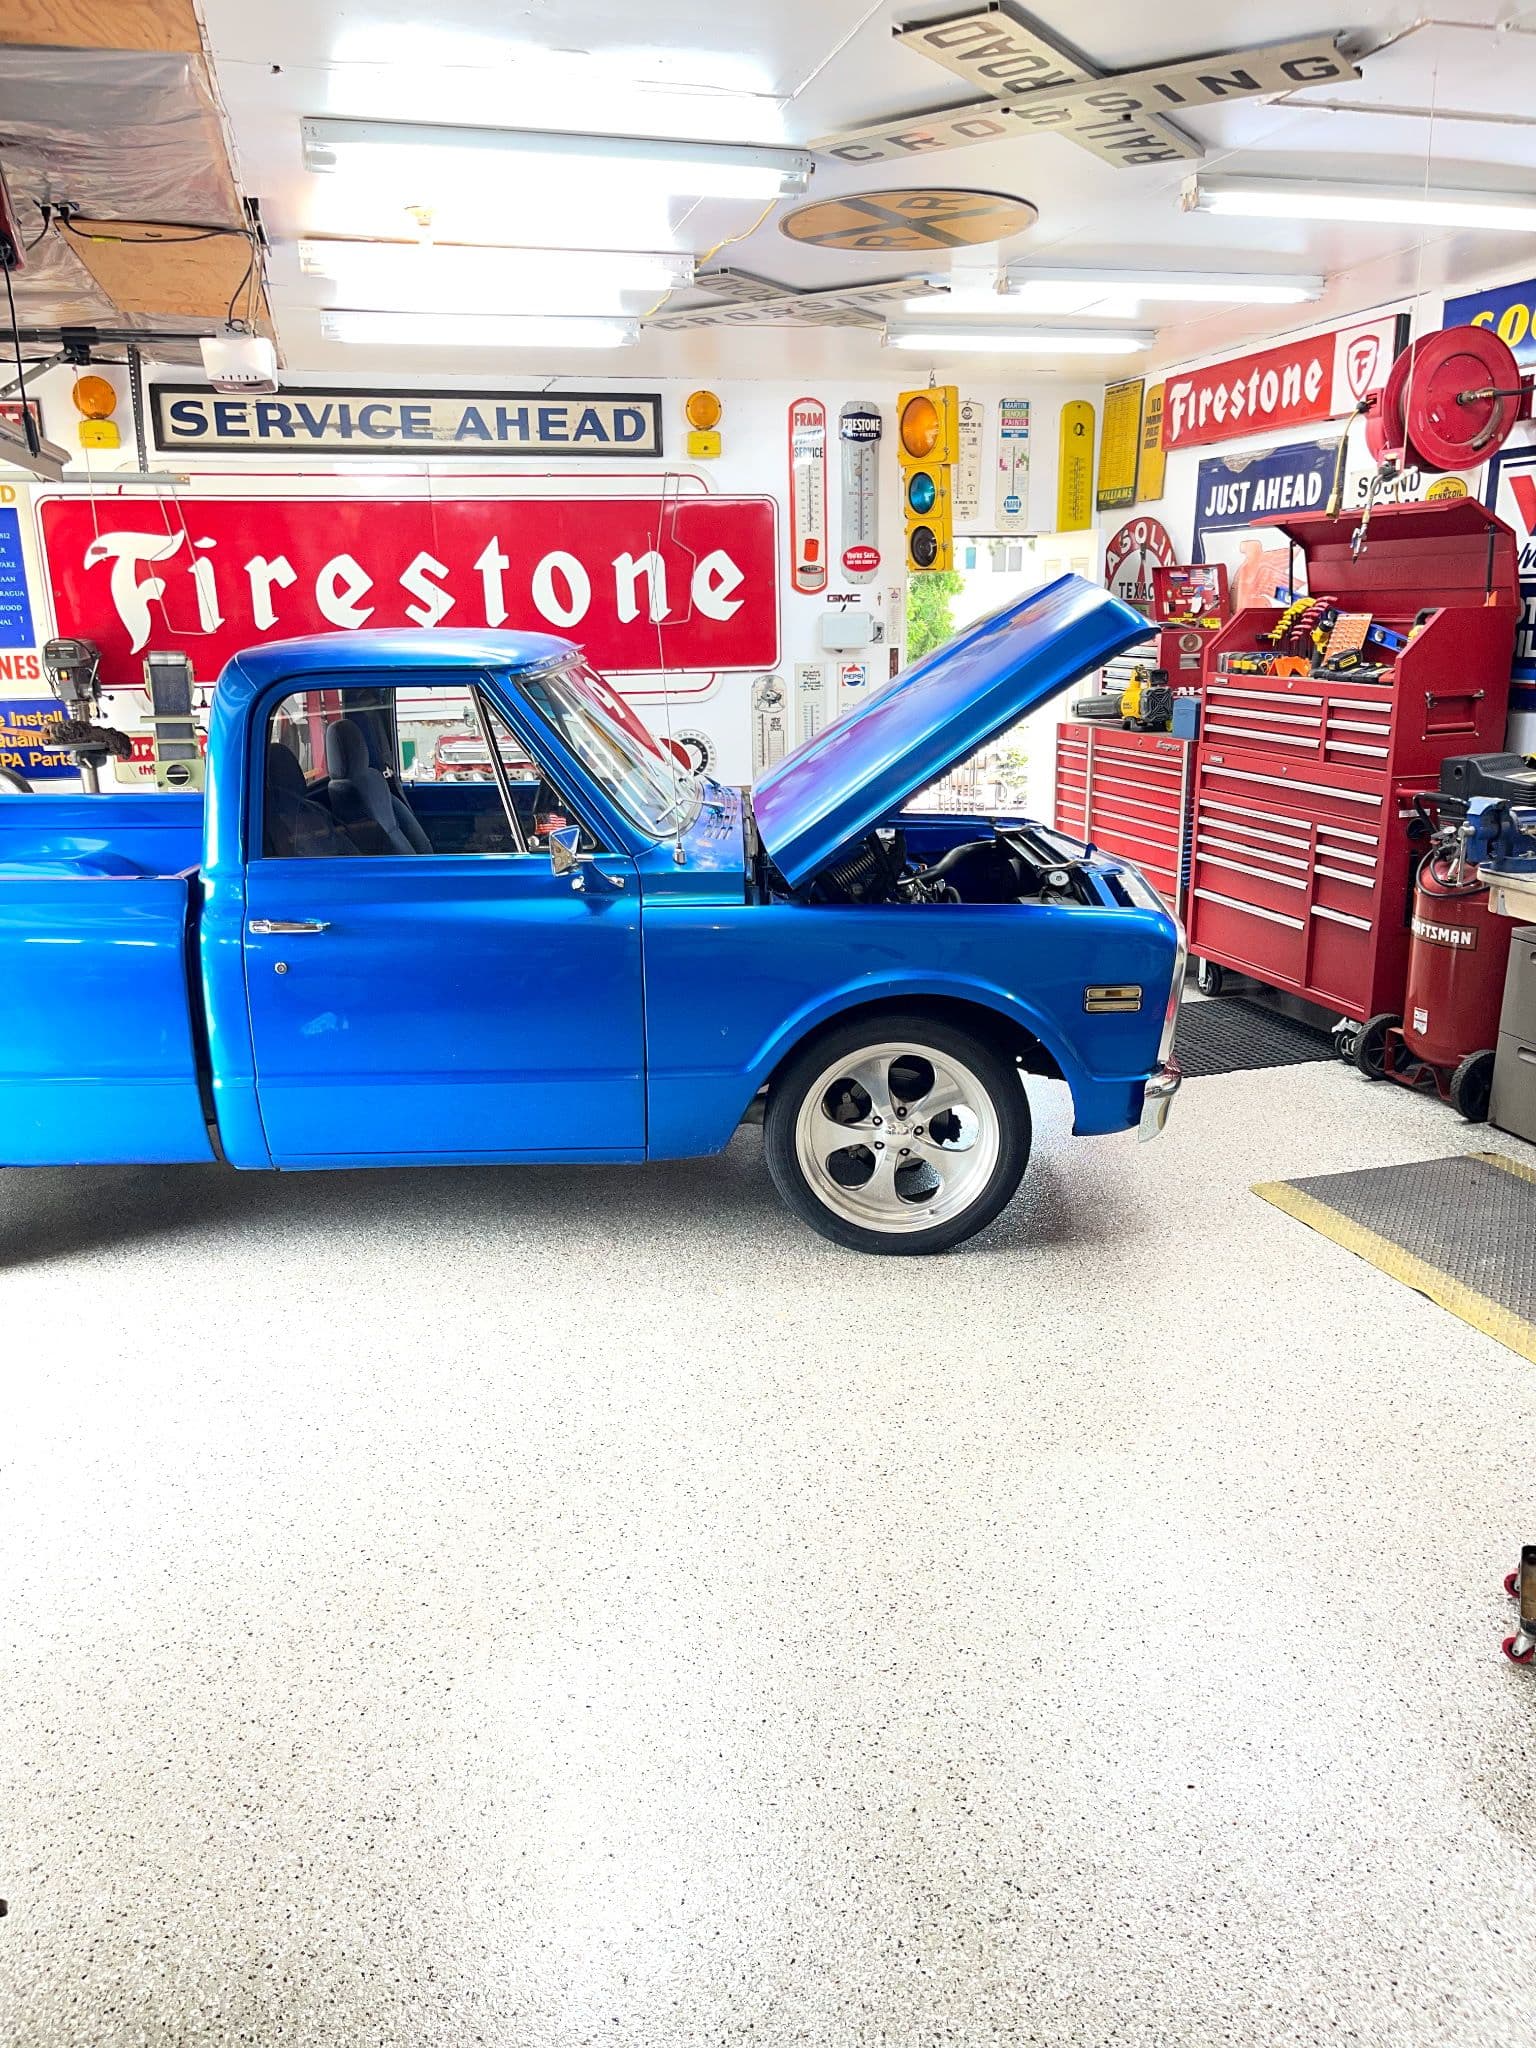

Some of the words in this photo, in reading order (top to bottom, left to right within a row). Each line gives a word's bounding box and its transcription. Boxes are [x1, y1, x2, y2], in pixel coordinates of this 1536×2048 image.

[1151, 397, 1161, 412] NO
[1169, 358, 1323, 442] Firestone
[170, 400, 434, 440] SERVICE
[455, 406, 646, 442] AHEAD
[795, 412, 822, 427] FRAM
[842, 418, 880, 431] PRESTONE
[794, 447, 823, 458] SERVICE
[1205, 481, 1250, 517] JUST
[1252, 471, 1322, 511] AHEAD
[84, 530, 745, 655] Firestone
[826, 594, 861, 602] GMC
[10, 710, 63, 727] Install
[29, 752, 76, 767] Parts
